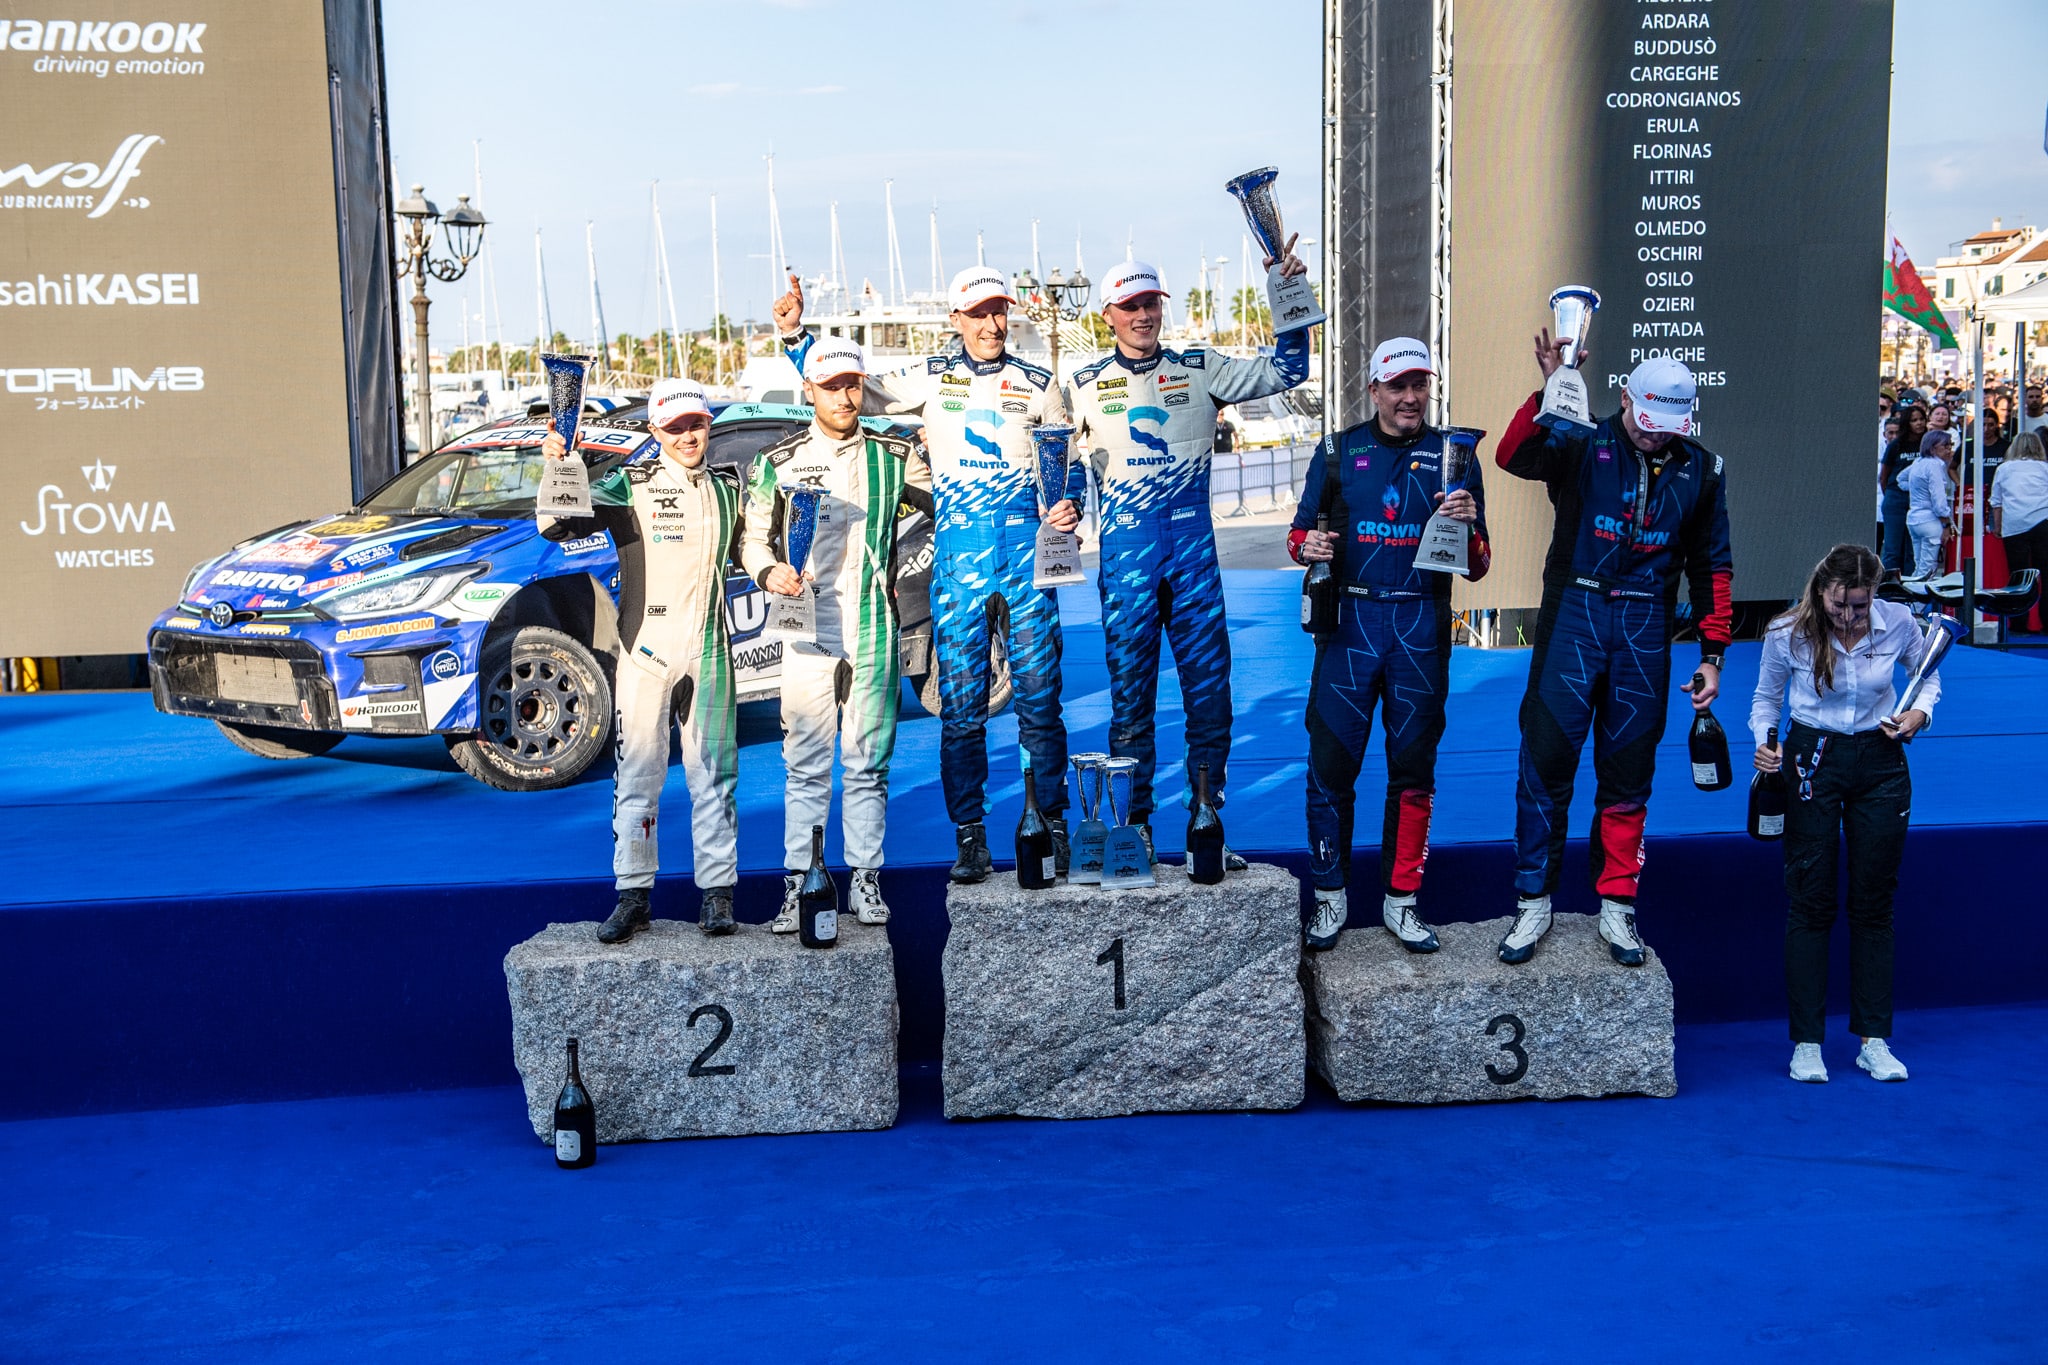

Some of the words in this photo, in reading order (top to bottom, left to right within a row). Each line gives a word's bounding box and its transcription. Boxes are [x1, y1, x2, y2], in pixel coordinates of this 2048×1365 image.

[1641, 13, 1710, 29] ARDARA
[1634, 36, 1717, 56] BUDDUSÒ
[33, 55, 110, 78] driving
[115, 58, 205, 75] emotion
[1630, 66, 1719, 82] CARGEGHE
[1606, 91, 1741, 108] CODRONGIANOS
[1647, 118, 1700, 133] ERULA
[1633, 143, 1712, 159] FLORINAS
[1649, 169, 1694, 185] ITTIRI
[0, 195, 94, 208] UBRICANTS
[1641, 195, 1701, 211] MUROS
[1635, 221, 1707, 237] OLMEDO
[1637, 246, 1703, 262] OSCHIRI
[1645, 271, 1694, 287] OSILO
[1642, 297, 1695, 312] OZIERI
[1632, 322, 1704, 338] PATTADA
[1630, 347, 1706, 363] PLOAGHE
[0, 367, 205, 393] ORUM8
[35, 396, 146, 411] フォーラムエイト
[959, 458, 1010, 470] RAUTIO
[1127, 454, 1177, 467] RAUTIO
[20, 484, 176, 536] STOWA
[652, 524, 686, 532] evecon
[1356, 520, 1422, 538] CROWN
[1357, 534, 1378, 543] GAS
[1384, 537, 1420, 547] POWER
[55, 549, 154, 568] WATCHES
[208, 569, 306, 592] RAUTIO
[647, 607, 667, 615] OMP
[336, 617, 435, 642] SJOMAN.COM
[1096, 938, 1126, 1011] 1
[686, 1004, 736, 1078] 2
[1484, 1013, 1529, 1085] 3
